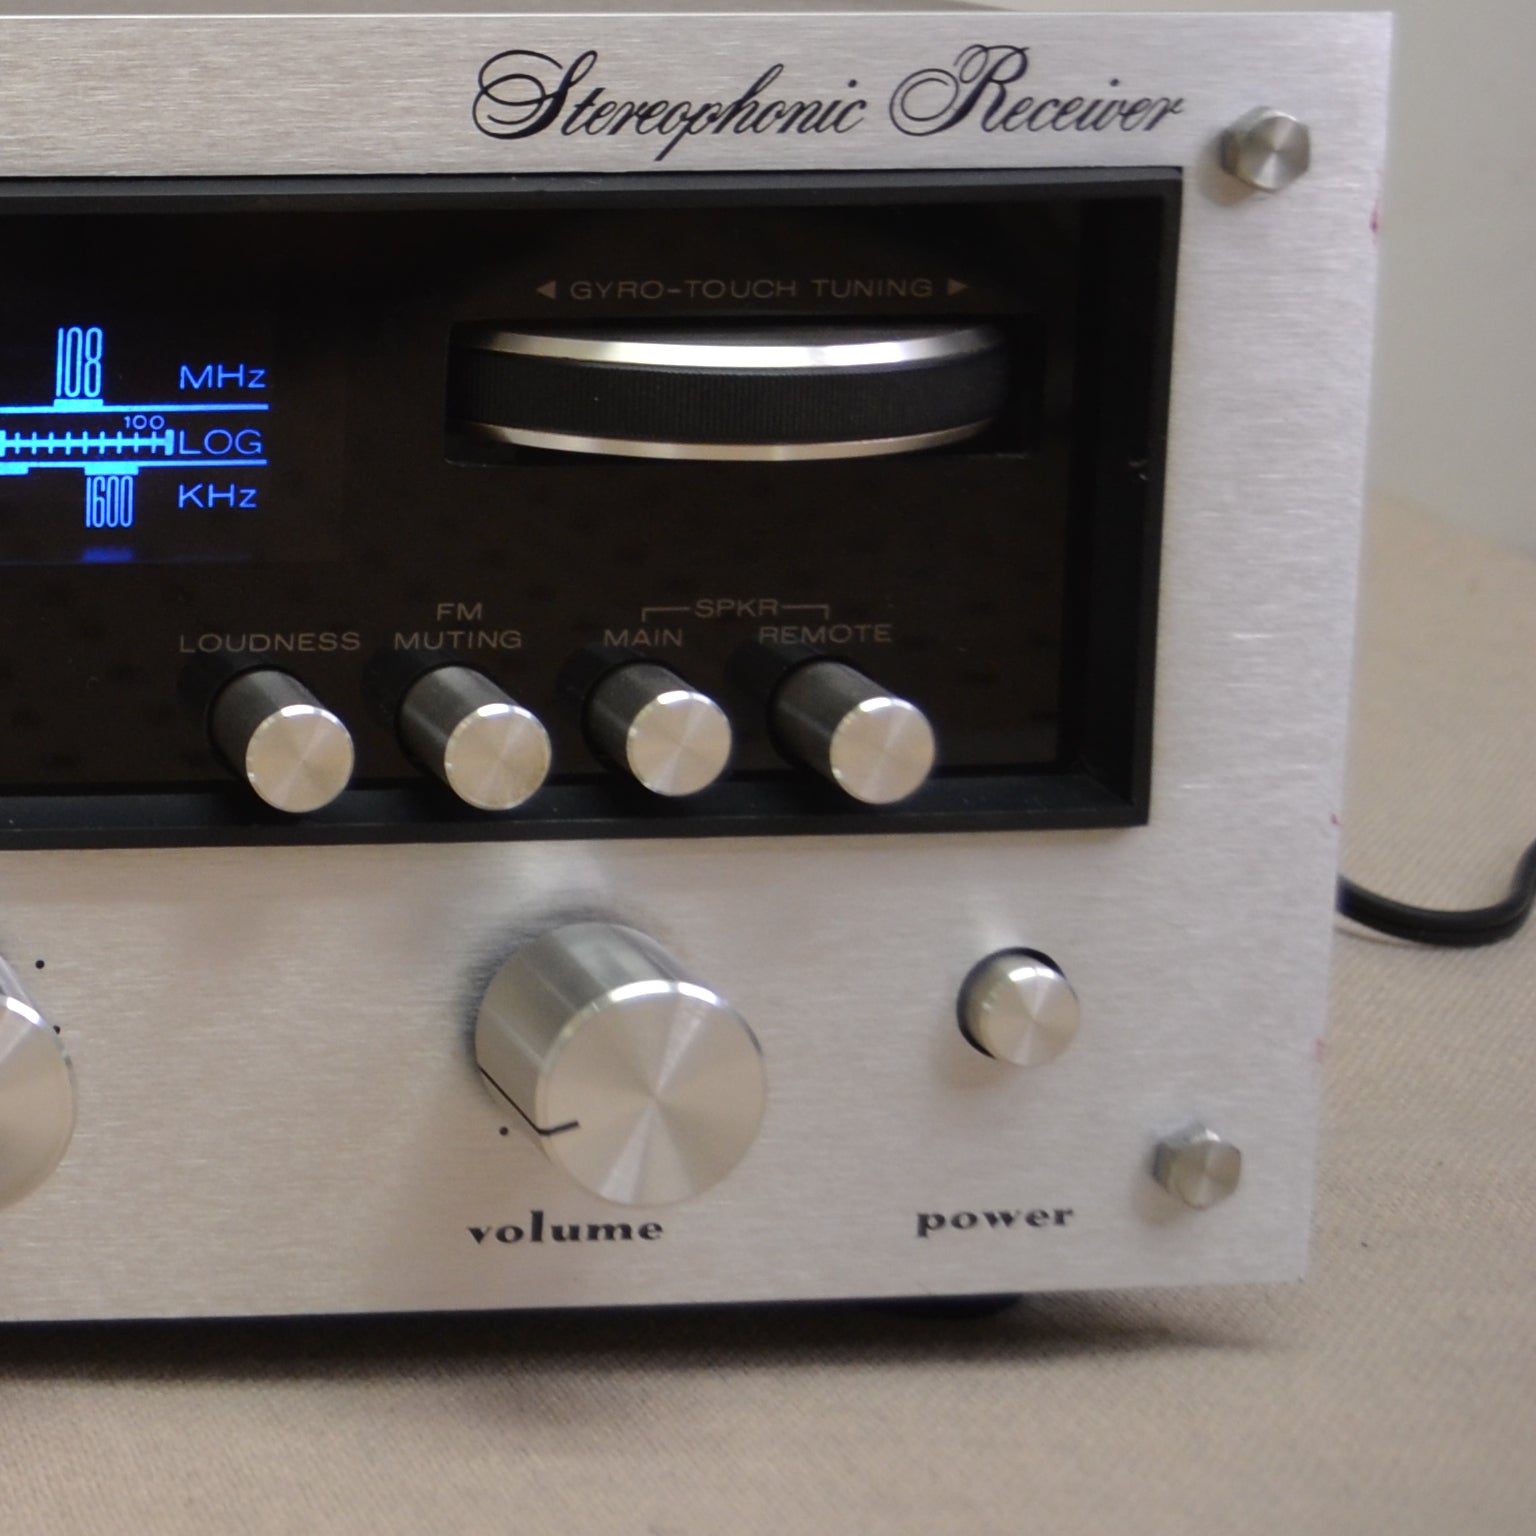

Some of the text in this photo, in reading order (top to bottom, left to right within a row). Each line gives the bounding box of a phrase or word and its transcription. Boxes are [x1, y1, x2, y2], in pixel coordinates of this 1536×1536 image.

[472, 43, 1185, 162] Stereophonic Receiver
[570, 277, 933, 301] GYRO-TOUCH TUNING
[55, 326, 103, 397] 108
[179, 364, 266, 390] MHz
[124, 414, 165, 431] 100
[178, 428, 263, 456] LOG
[85, 475, 134, 527] 1600
[178, 483, 258, 509] KHz
[436, 602, 483, 622] FM
[694, 598, 779, 618] SPKR
[180, 634, 361, 653] LOUDNESS
[394, 631, 522, 650] MUTING
[604, 628, 683, 647] MAIN
[758, 624, 892, 644] REMOTE
[468, 1210, 665, 1245] volume
[915, 1205, 1074, 1238] power
